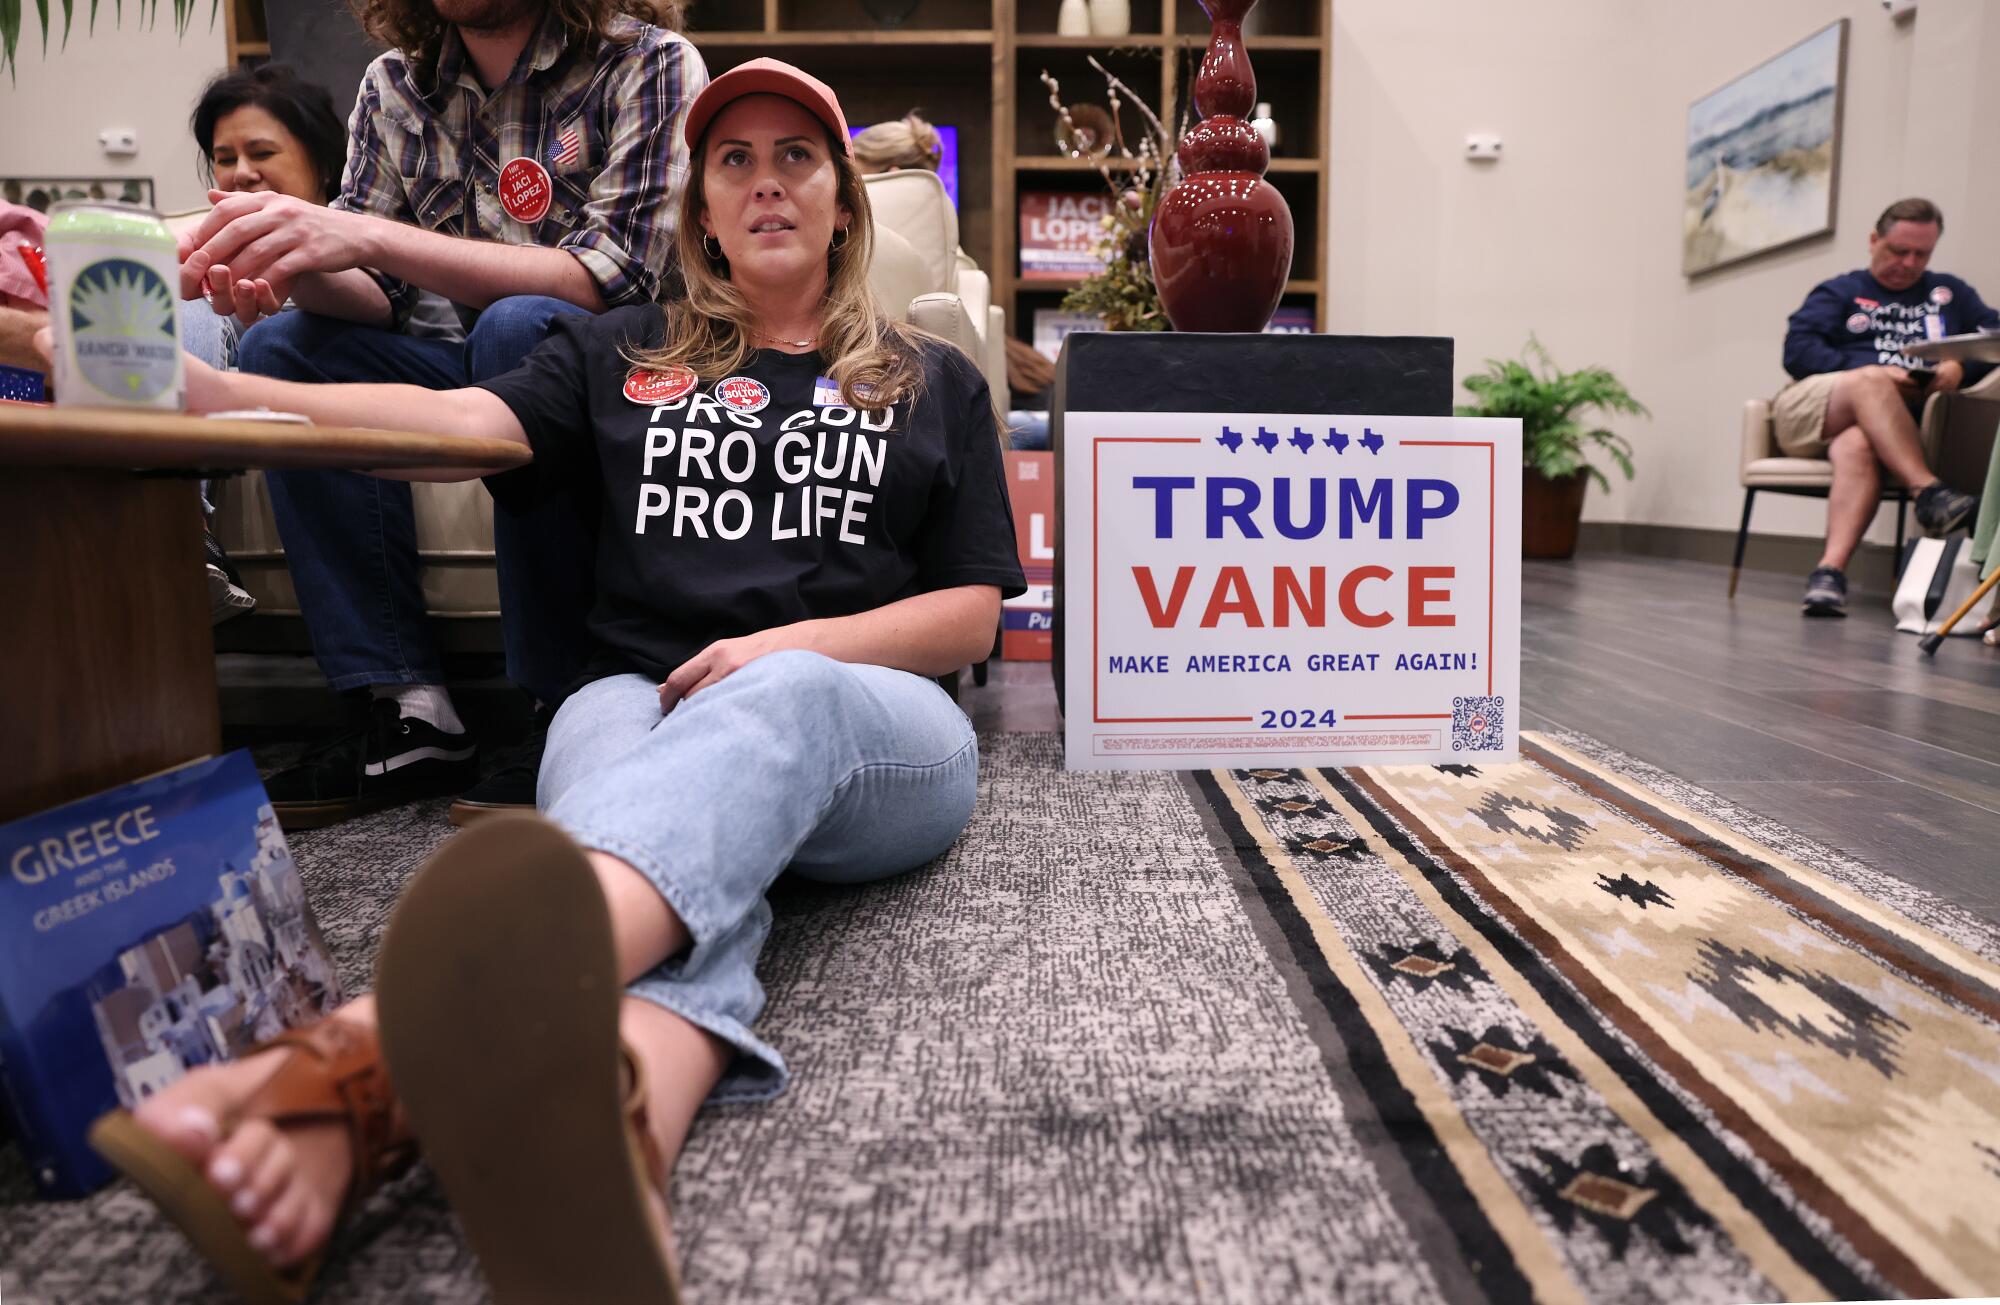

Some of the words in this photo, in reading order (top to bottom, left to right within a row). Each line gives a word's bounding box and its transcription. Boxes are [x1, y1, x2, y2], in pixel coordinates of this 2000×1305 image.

[511, 174, 532, 194] JACI
[511, 183, 542, 208] LOPEZ
[1048, 197, 1109, 221] JACI
[638, 379, 682, 392] LOPEZ
[724, 389, 762, 399] BOLTON
[731, 383, 750, 391] TIM
[650, 393, 762, 429] PRO
[779, 405, 894, 432] GOD
[642, 427, 756, 483] PRO
[774, 431, 887, 488] GUN
[634, 483, 753, 541] PRO
[771, 485, 873, 545] LIFE
[1132, 476, 1460, 540] TRUMP
[1131, 565, 1456, 628] VANCE
[1109, 656, 1169, 673] MAKE
[1186, 654, 1291, 673] AMERICA
[1308, 654, 1380, 672] GREAT
[1395, 653, 1478, 671] AGAIN!
[1260, 709, 1337, 730] 2024
[11, 805, 161, 885] GREECE
[33, 890, 103, 932] GREEK
[101, 857, 177, 903] ISLANDS
